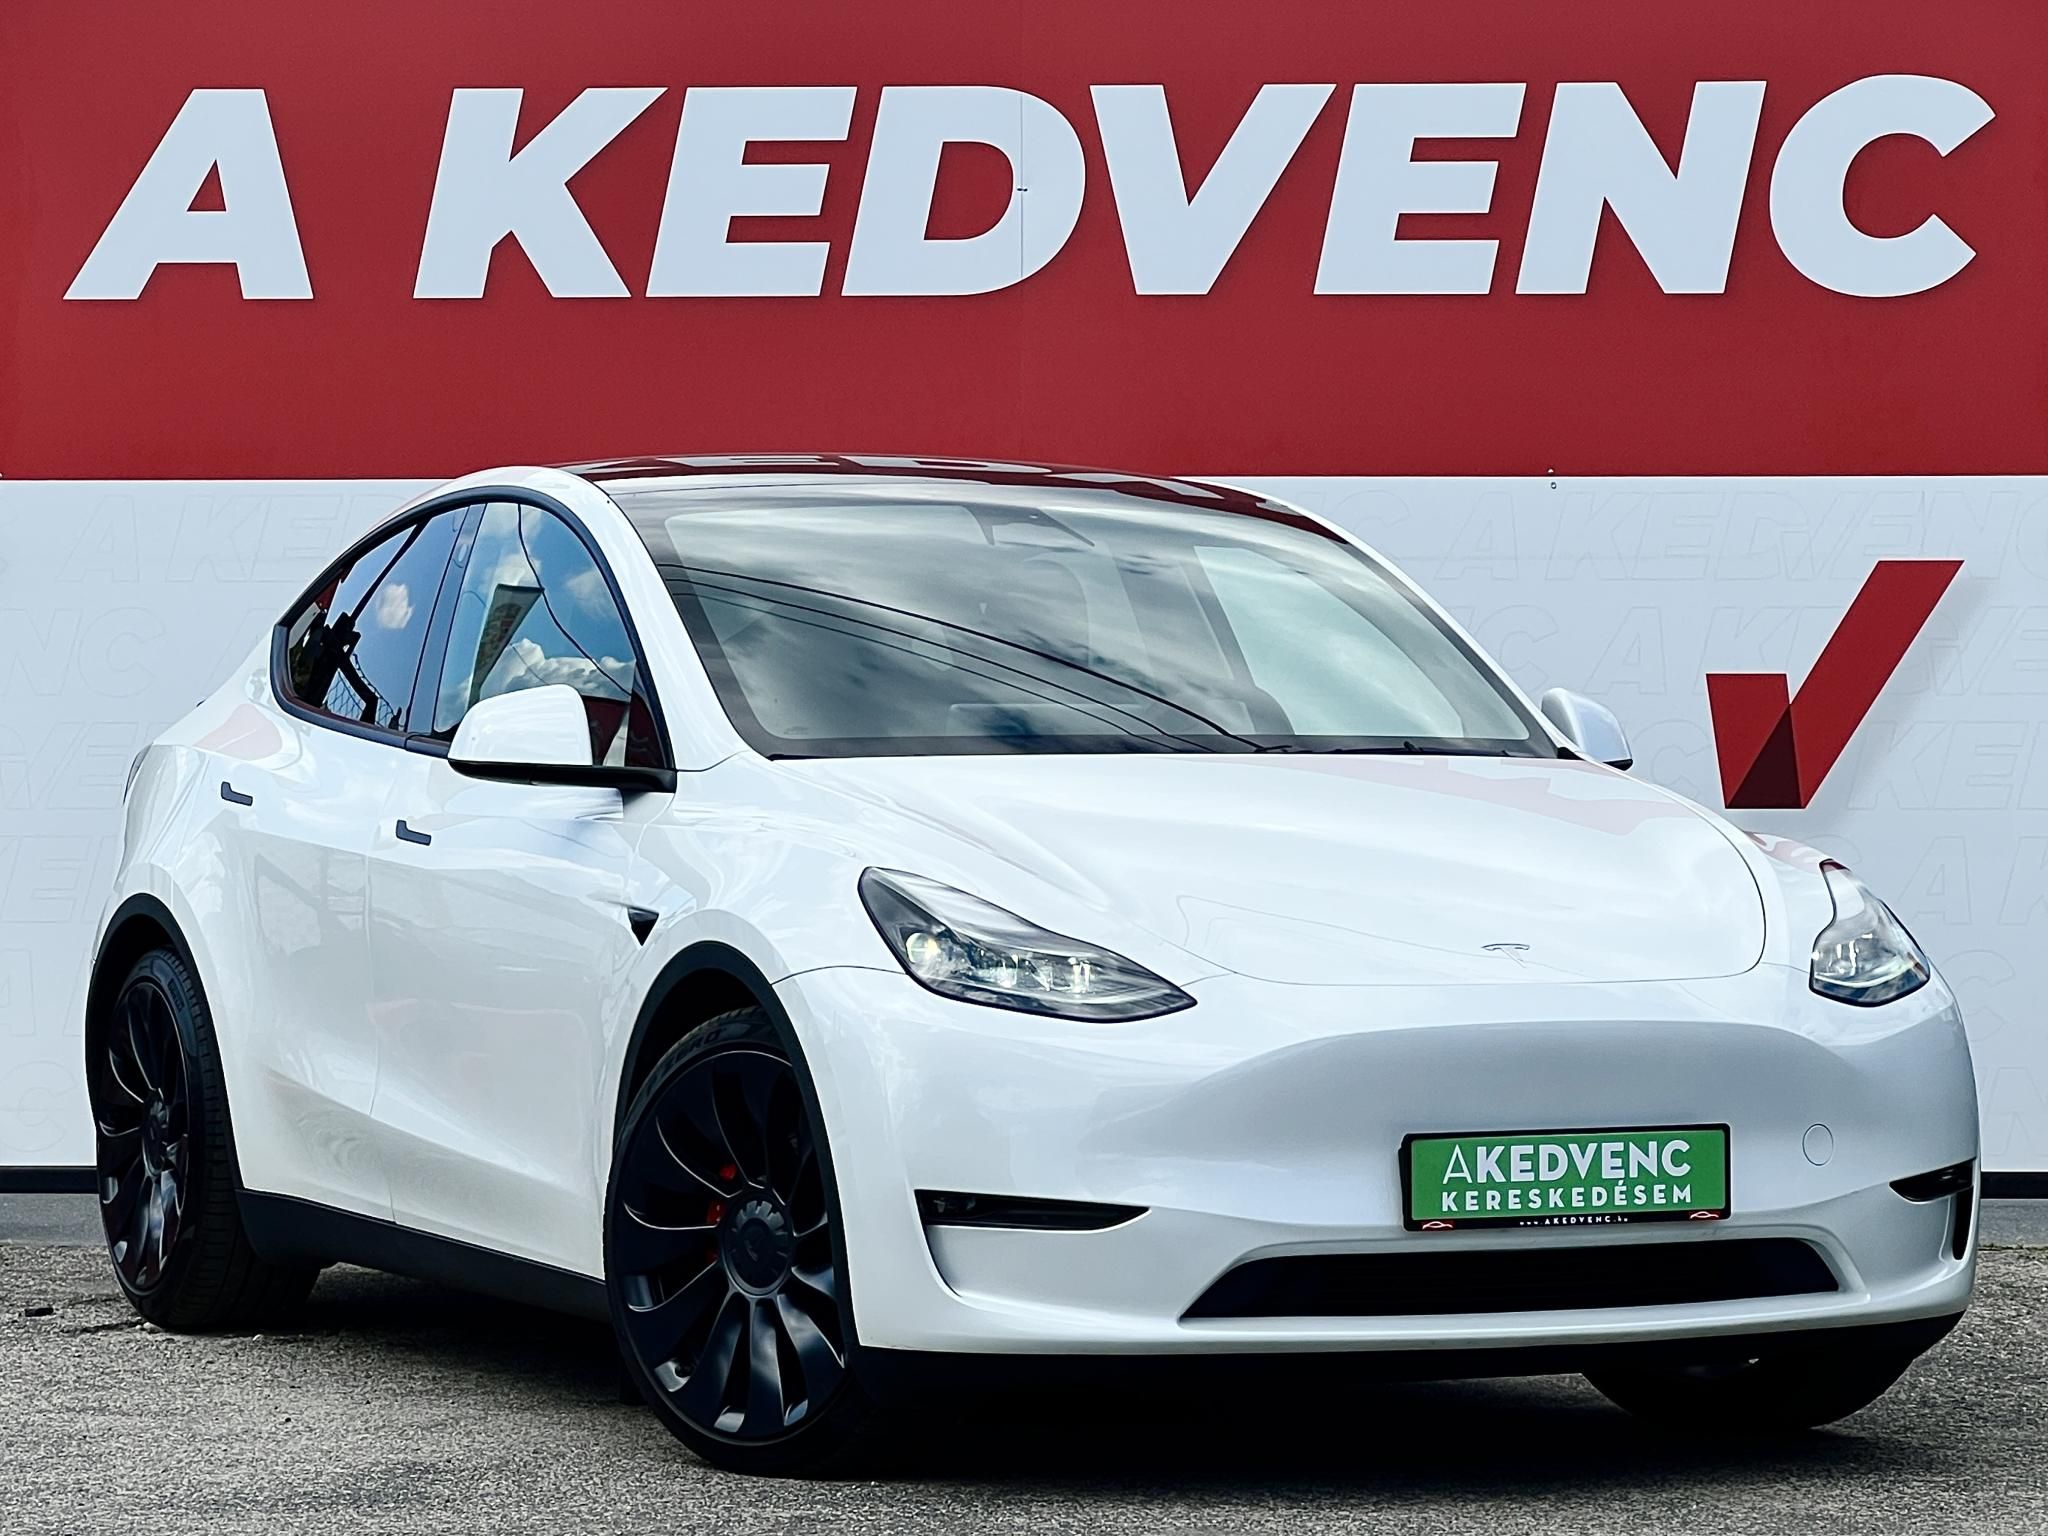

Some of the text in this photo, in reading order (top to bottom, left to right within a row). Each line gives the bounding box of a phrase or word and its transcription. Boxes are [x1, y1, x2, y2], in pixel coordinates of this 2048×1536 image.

[62, 73, 1997, 300] A KEDVENC
[1442, 1139, 1692, 1185] AKEDVENC
[1442, 1180, 1692, 1212] KERESKEDÉSEM
